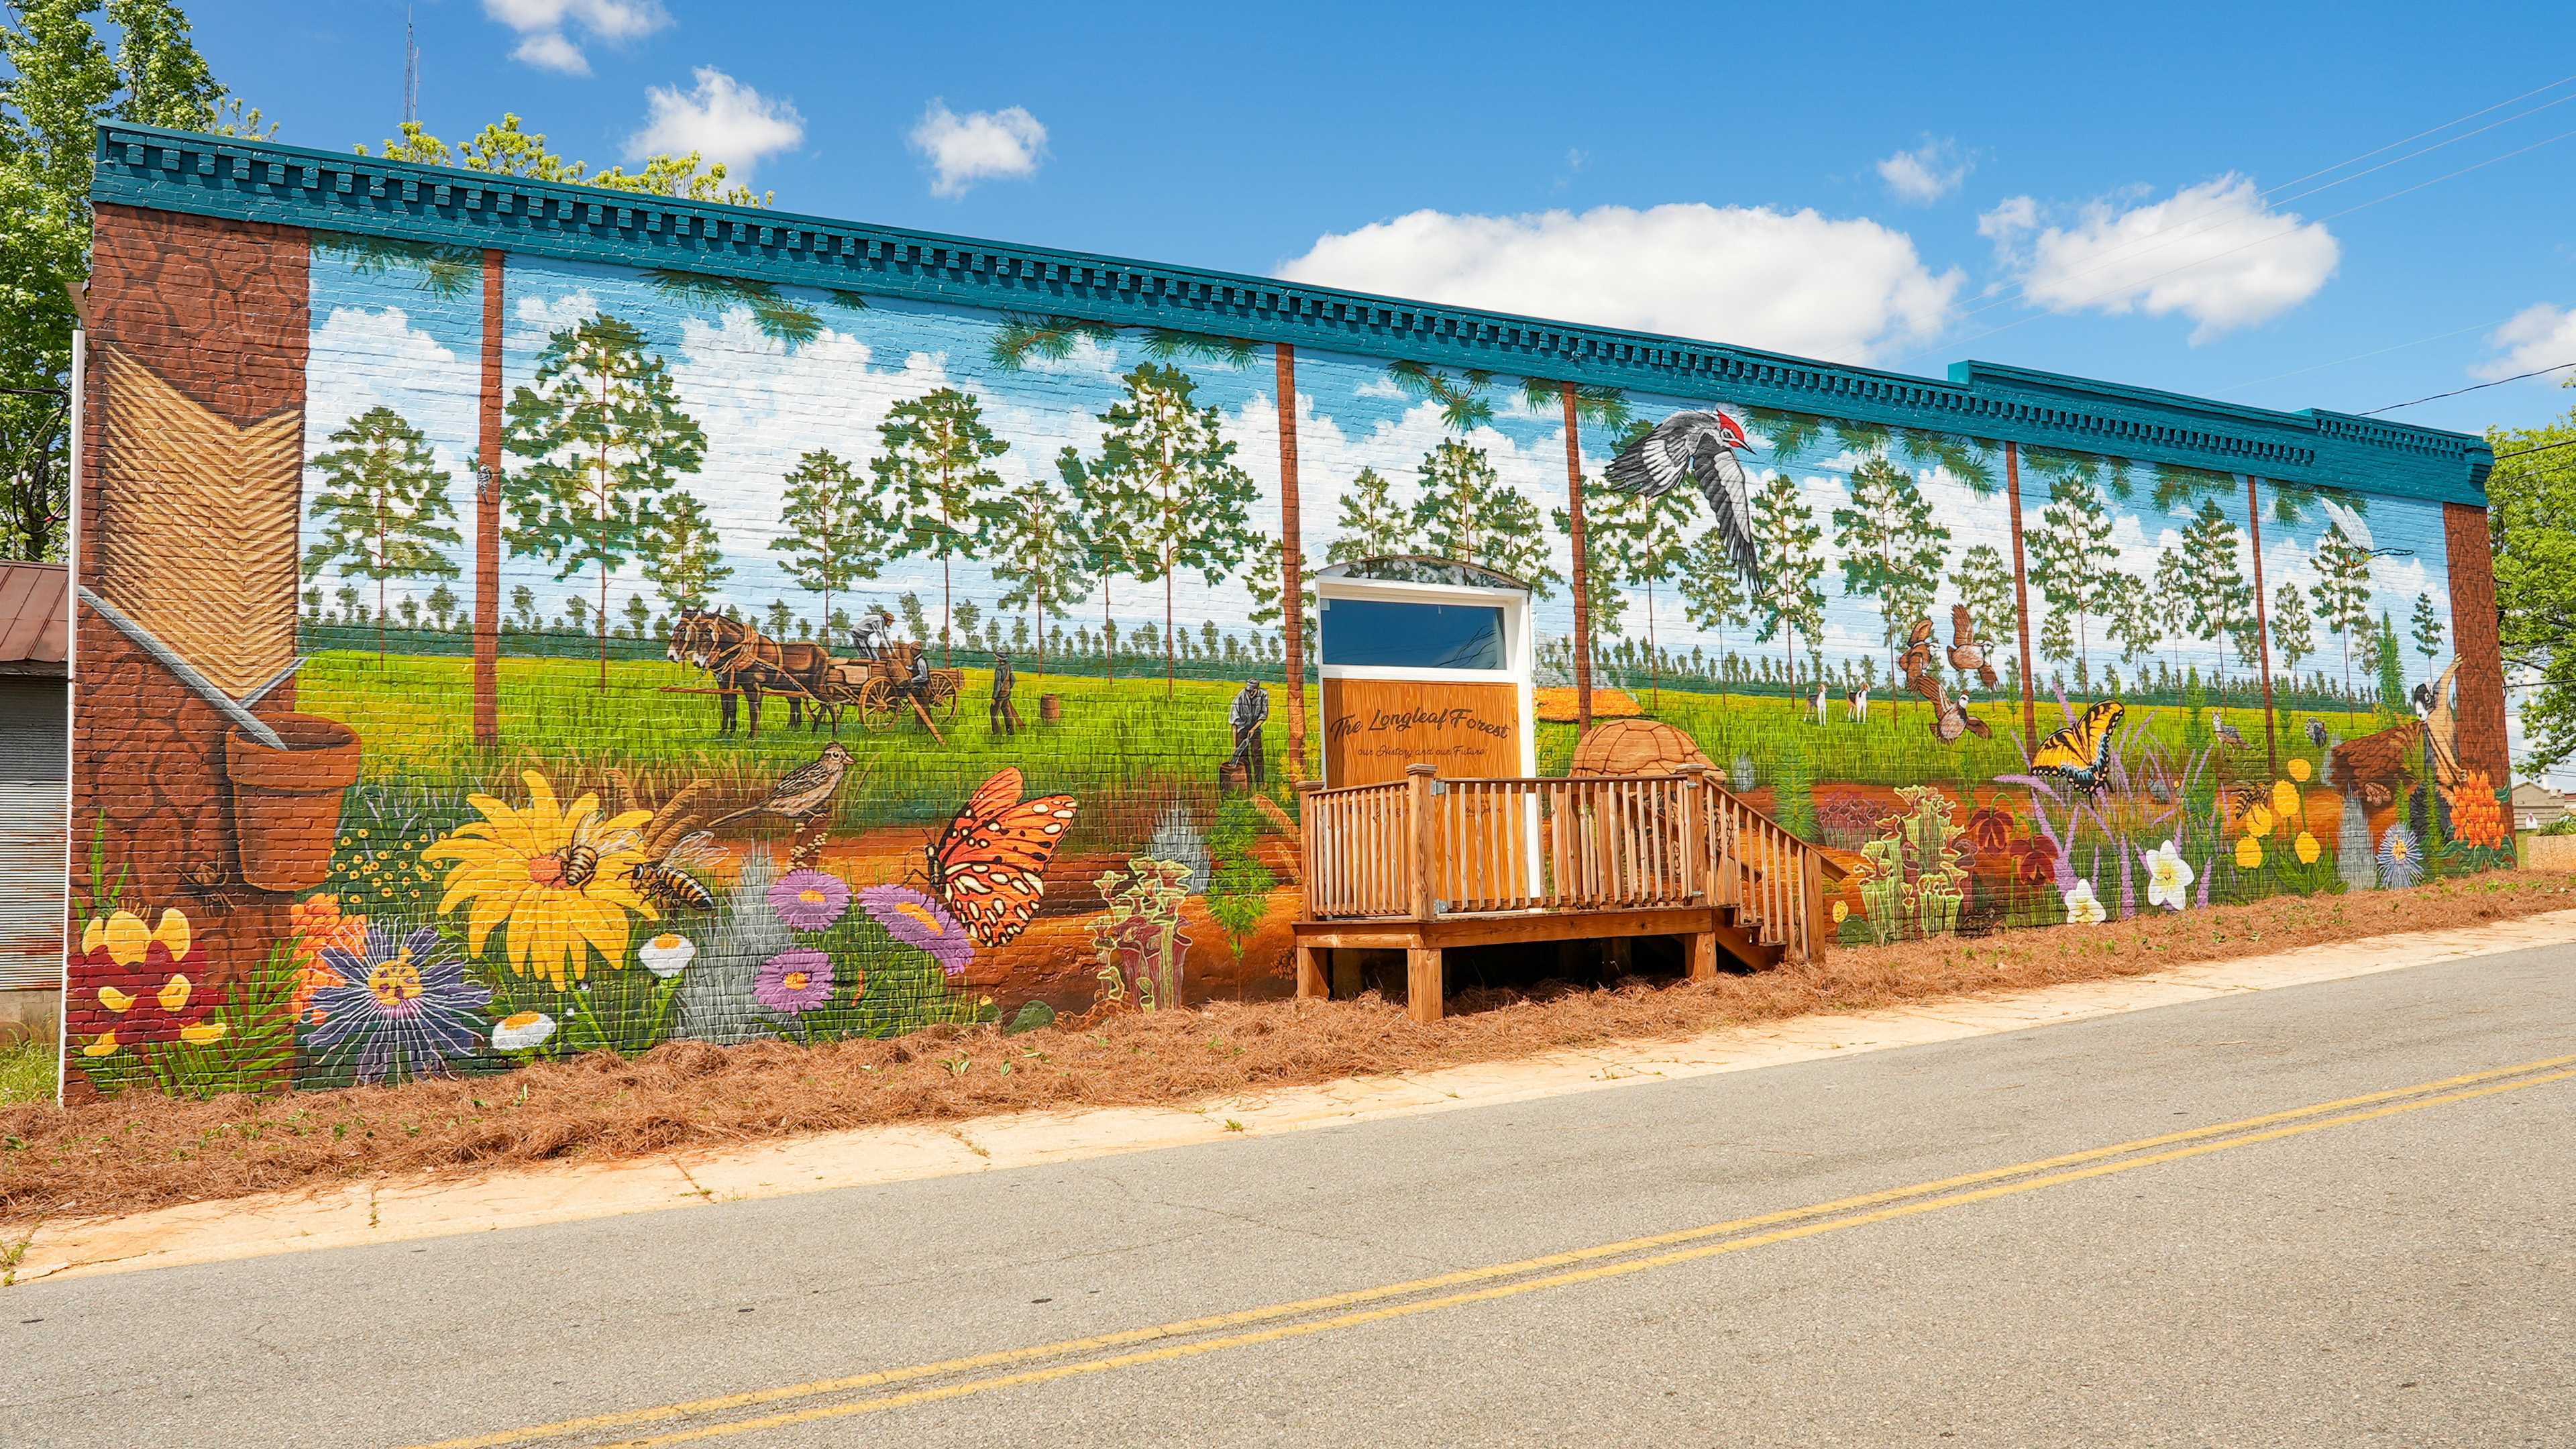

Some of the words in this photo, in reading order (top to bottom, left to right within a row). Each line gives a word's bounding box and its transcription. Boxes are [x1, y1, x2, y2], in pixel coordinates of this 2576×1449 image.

[1330, 714, 1362, 743] The
[1368, 706, 1448, 732] Longleaf
[1450, 708, 1511, 739] Forest
[1376, 745, 1413, 759] History
[1415, 747, 1434, 756] and
[1452, 745, 1485, 757] Future
